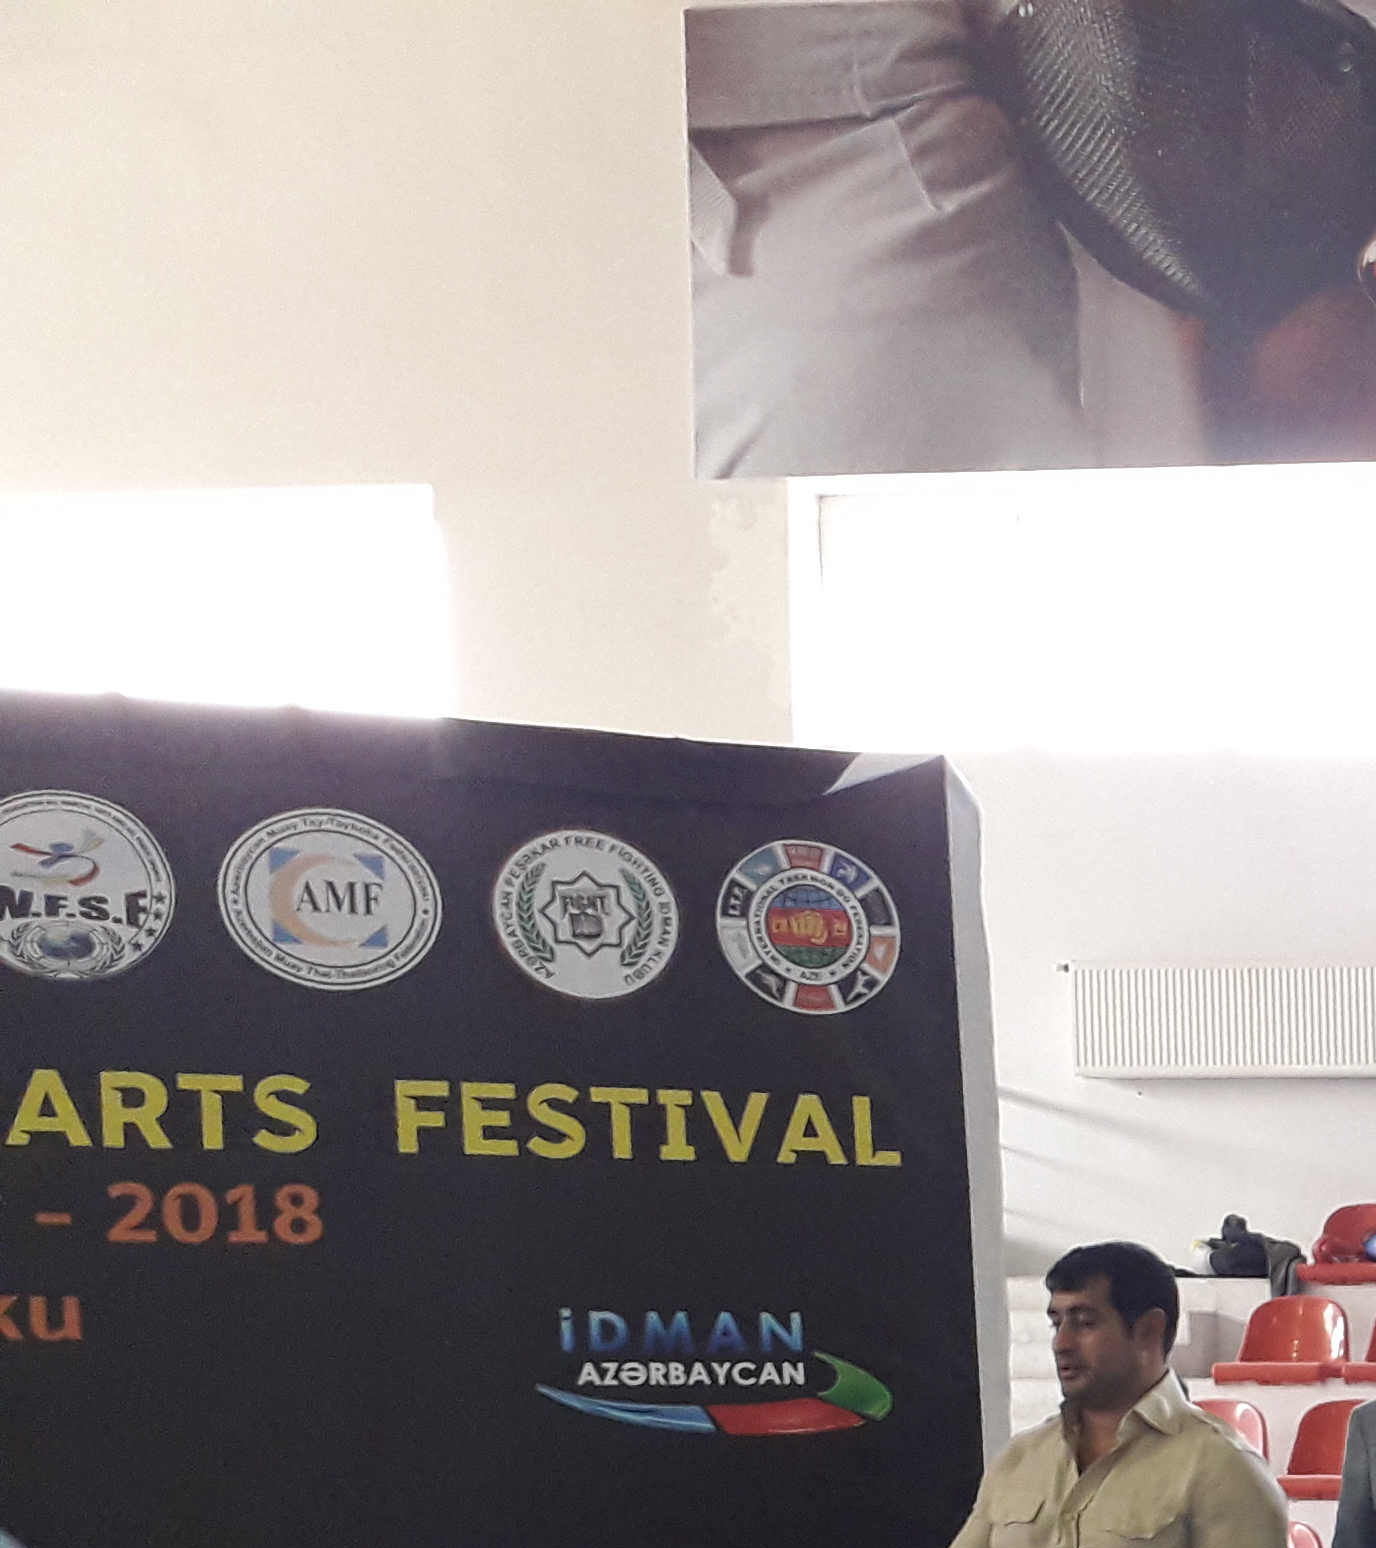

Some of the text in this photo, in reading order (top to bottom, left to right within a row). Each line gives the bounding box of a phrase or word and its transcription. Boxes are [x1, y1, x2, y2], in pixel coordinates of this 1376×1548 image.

[296, 880, 383, 916] AMF
[5, 1068, 902, 1167] ARTS FESTIVAL
[106, 1182, 323, 1244] 2018
[577, 1361, 806, 1386] AZƏRBAYCAN
